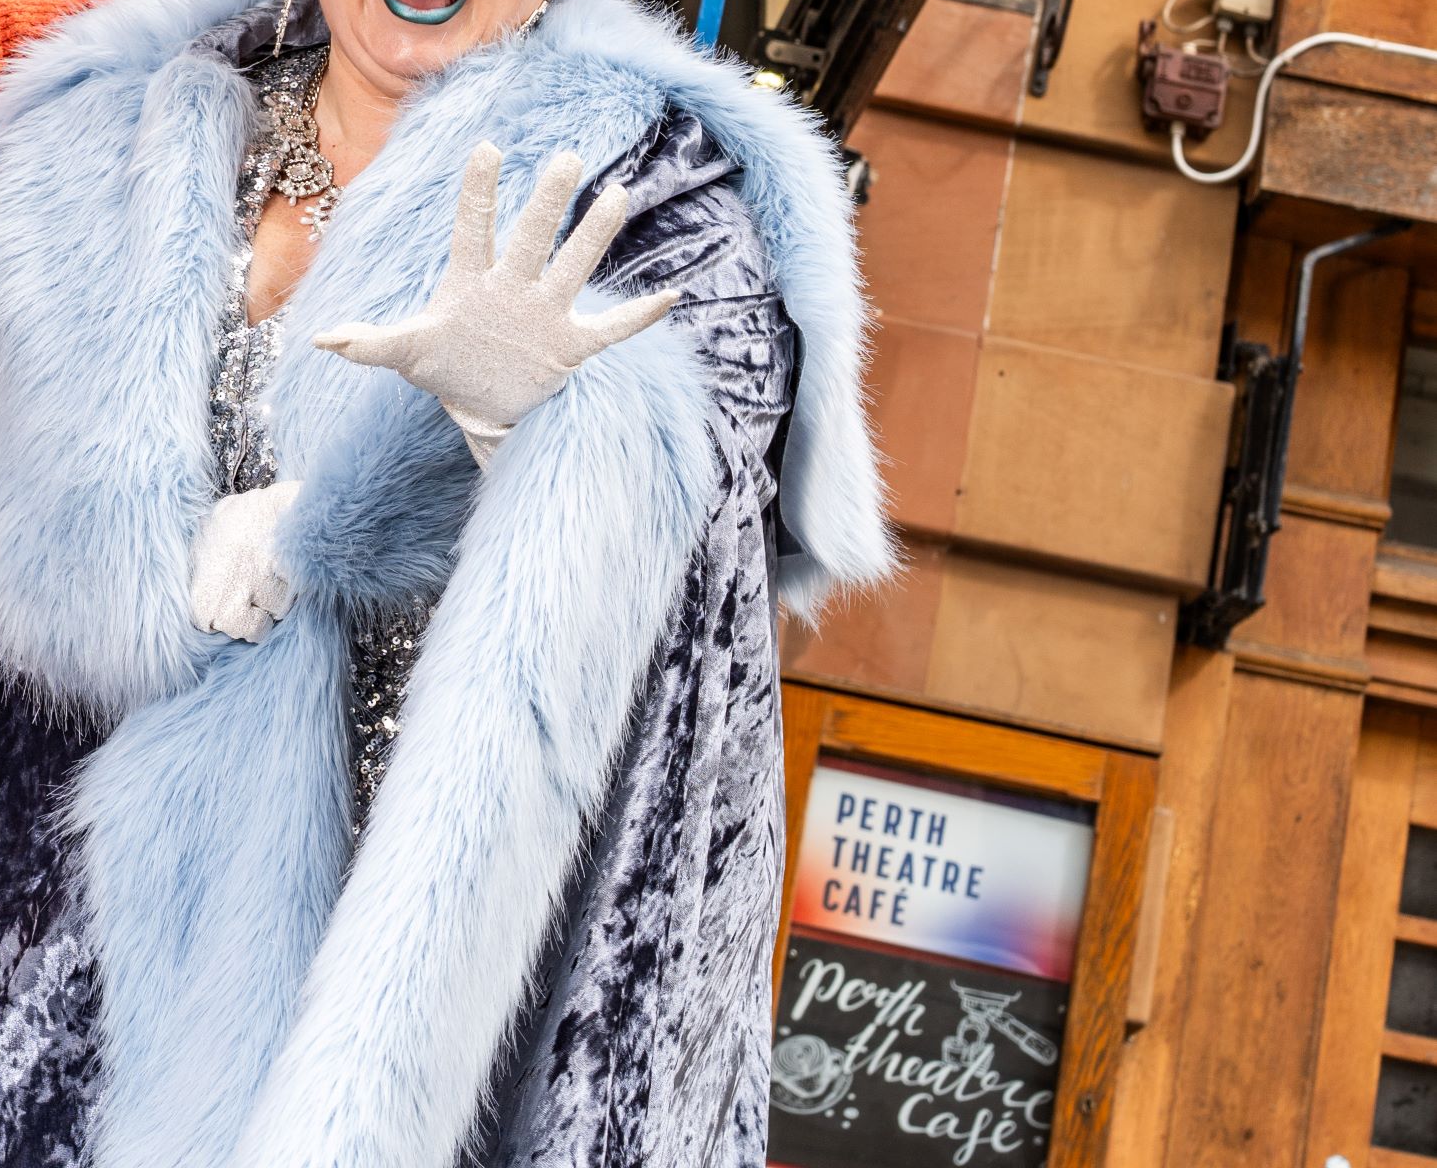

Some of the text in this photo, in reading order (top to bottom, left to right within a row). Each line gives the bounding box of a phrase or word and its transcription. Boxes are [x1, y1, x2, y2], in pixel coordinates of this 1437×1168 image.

[835, 793, 948, 847] PERTH
[832, 836, 984, 900] THEATRE
[822, 880, 909, 927] CAFÉ
